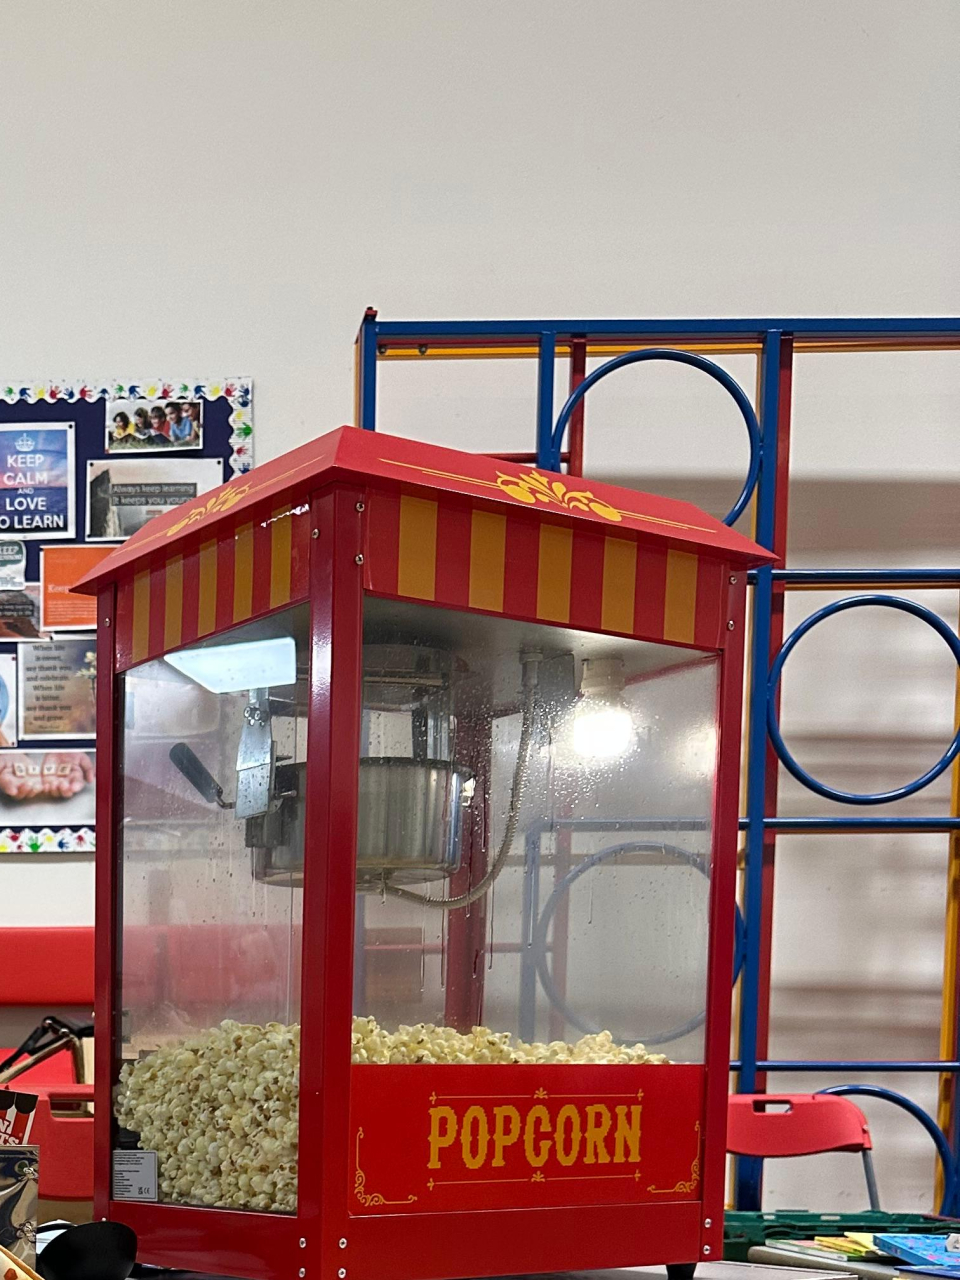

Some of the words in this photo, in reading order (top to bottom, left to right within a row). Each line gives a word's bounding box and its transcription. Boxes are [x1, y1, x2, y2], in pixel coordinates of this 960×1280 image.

[6, 454, 45, 468] KEEP
[3, 471, 48, 486] CALM
[112, 485, 140, 493] Always
[141, 484, 160, 493] keep
[161, 484, 194, 493] learning
[5, 497, 47, 511] LOVE
[120, 496, 146, 505] keeps
[147, 497, 164, 505] you
[13, 514, 64, 529] LEARN
[38, 704, 58, 712] thank
[427, 1103, 643, 1170] POPCORN
